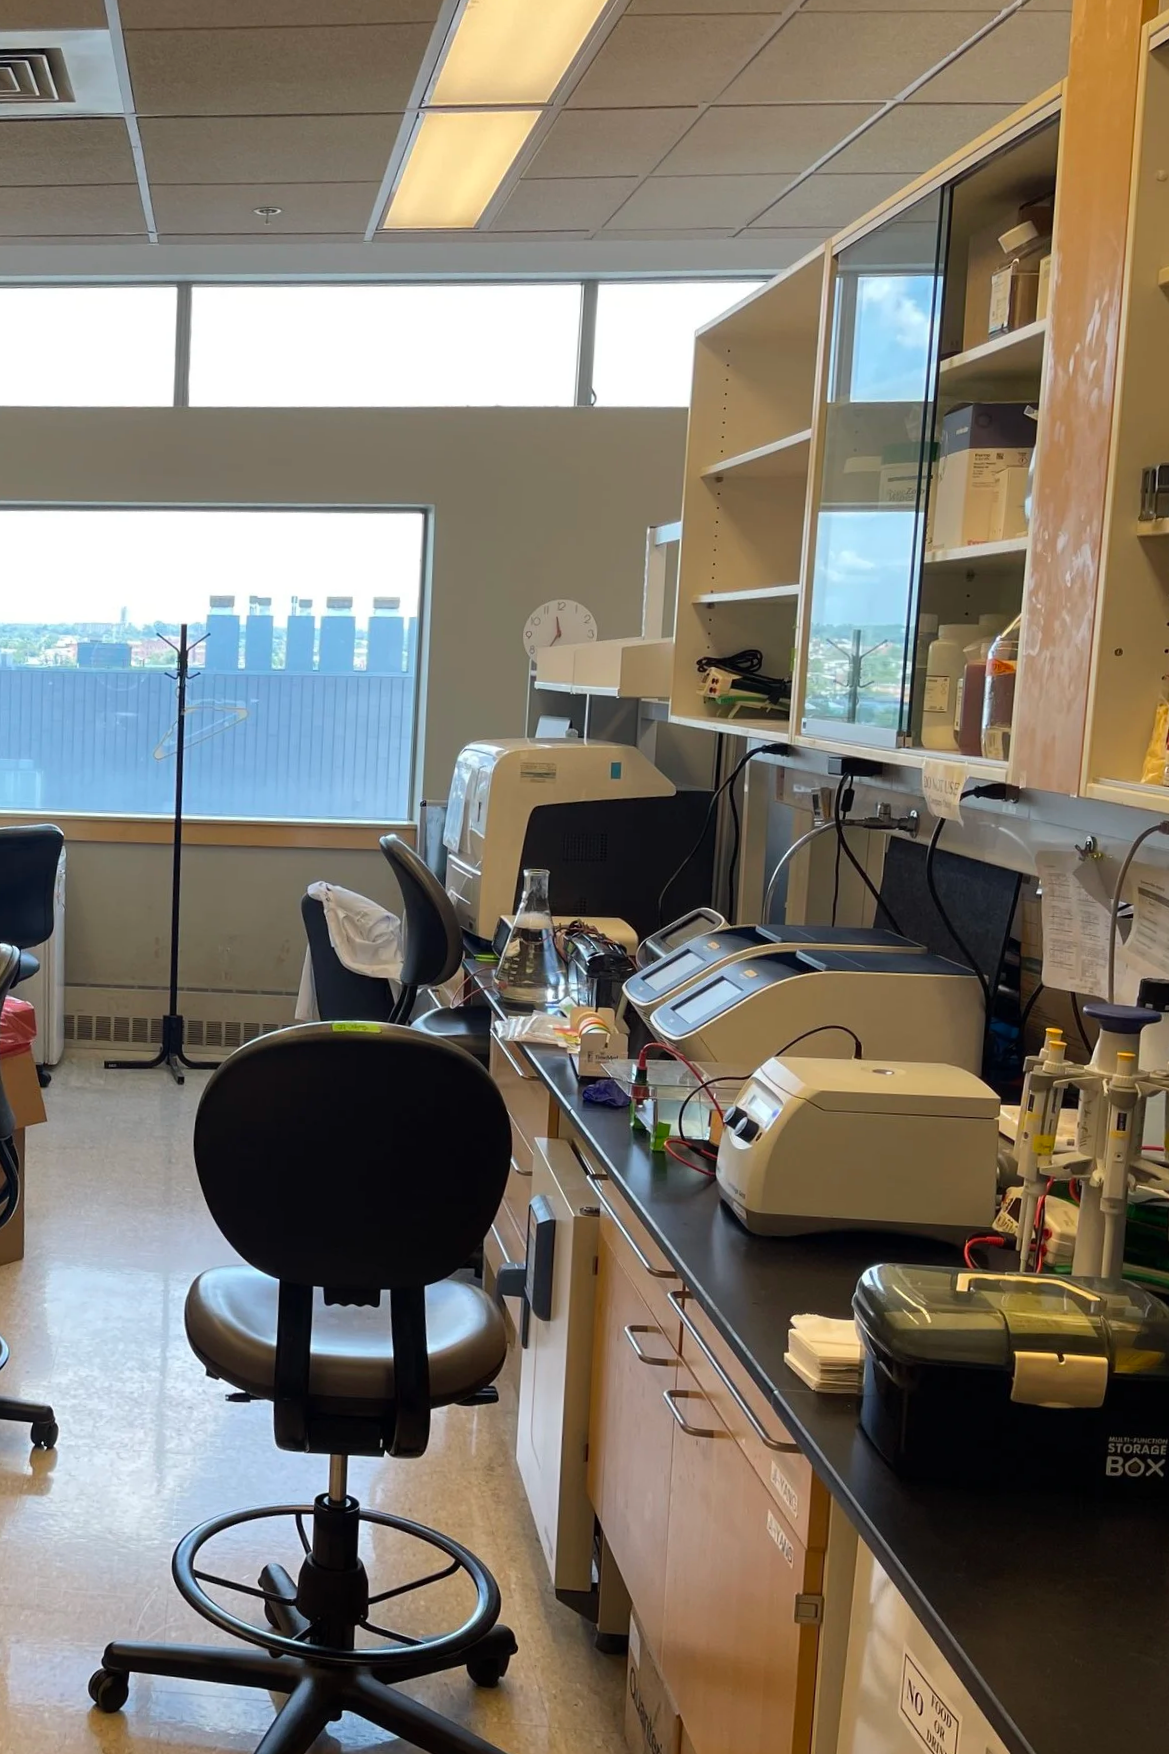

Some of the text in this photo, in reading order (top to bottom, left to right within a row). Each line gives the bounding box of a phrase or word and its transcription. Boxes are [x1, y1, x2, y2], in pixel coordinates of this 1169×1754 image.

[543, 605, 550, 615] 11
[557, 601, 567, 611] 12
[530, 616, 541, 626] 10
[583, 614, 591, 624] 2
[525, 630, 533, 640] 9
[587, 629, 595, 639] 3
[529, 645, 535, 655] 8
[944, 780, 961, 796] USE
[1108, 1436, 1169, 1445] MULTI-FUNCTION
[1107, 1442, 1167, 1455] STORAGE
[1105, 1455, 1166, 1478] BOX
[906, 1677, 924, 1717] NO
[931, 1694, 952, 1729] FOOD
[934, 1719, 945, 1742] OR
